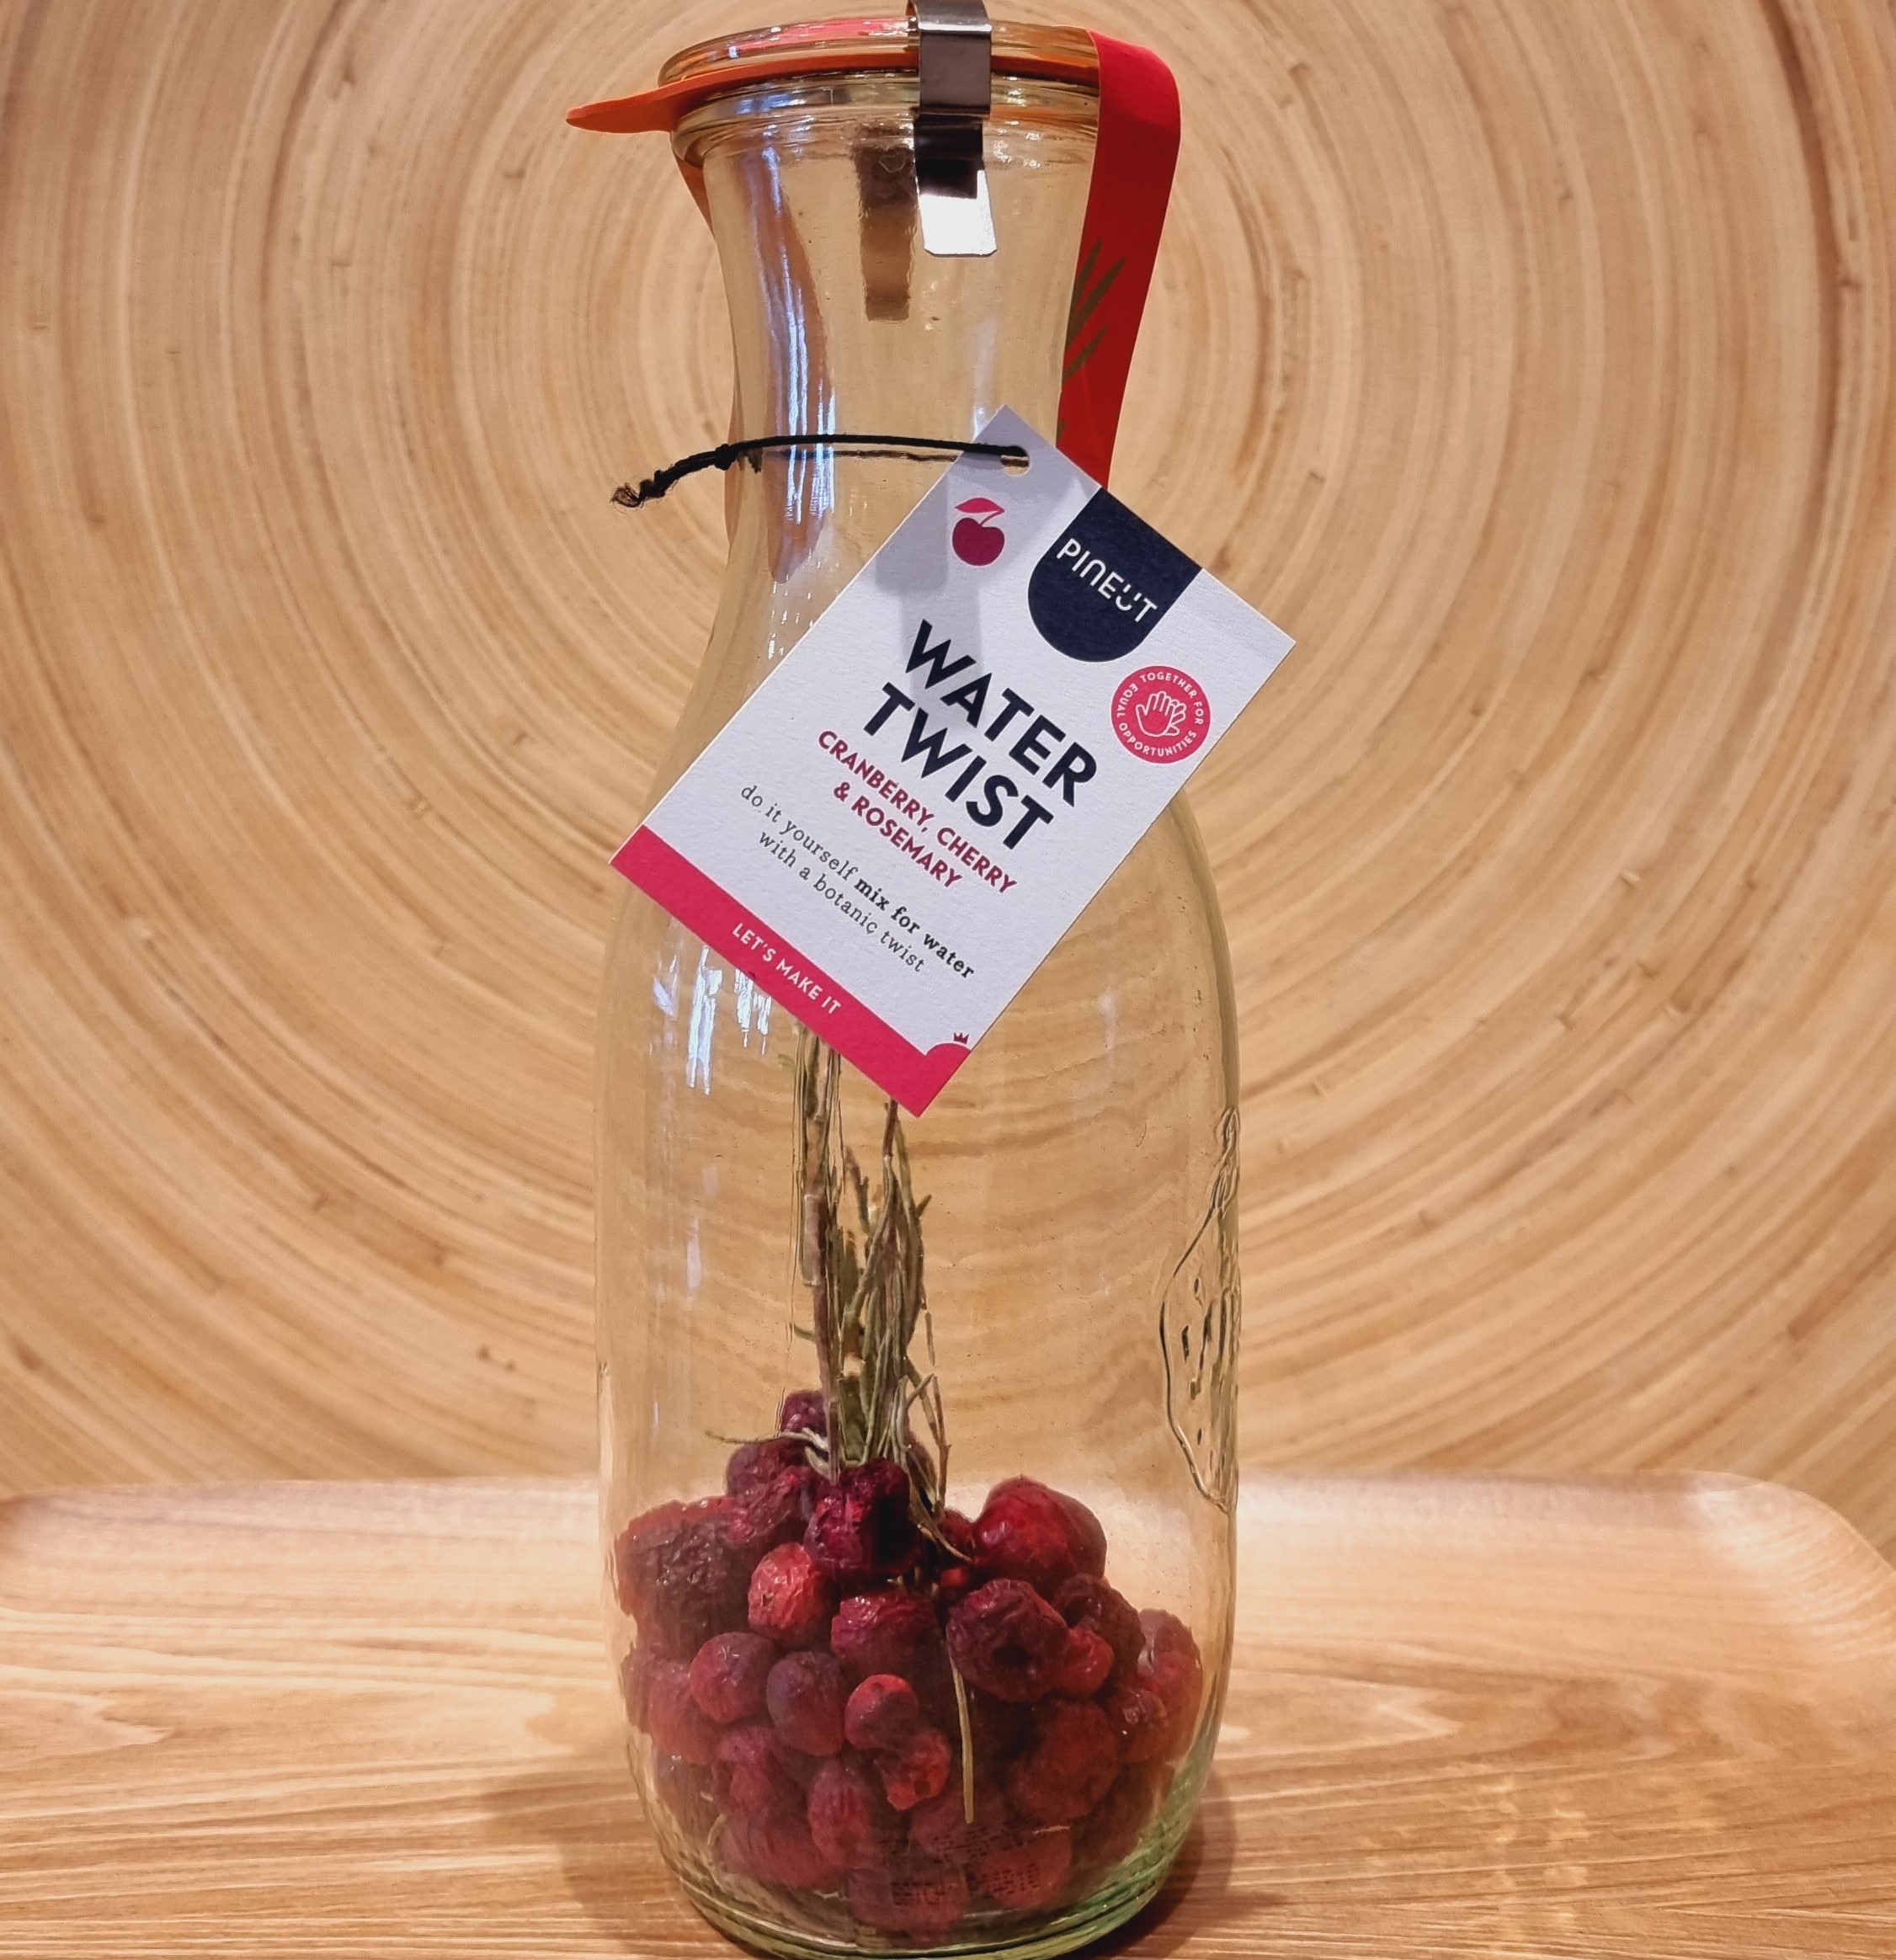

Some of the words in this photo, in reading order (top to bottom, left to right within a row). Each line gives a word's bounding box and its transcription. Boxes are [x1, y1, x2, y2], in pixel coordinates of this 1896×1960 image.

[905, 619, 1097, 808] WATER
[1116, 683, 1138, 718] EQUAL
[1119, 722, 1197, 757] OPPORTUNITIES
[1139, 672, 1197, 699] TOGETHER
[1194, 701, 1204, 725] FOR
[818, 731, 935, 833] CRANBERRY,
[936, 827, 1017, 893] CHERRY
[863, 681, 1054, 850] TWIST
[741, 785, 763, 807] do
[765, 803, 782, 823] it
[780, 820, 859, 881] yourself
[854, 878, 890, 911] mix
[890, 906, 920, 935] for
[923, 934, 975, 978] water
[833, 781, 850, 802] &
[850, 795, 963, 887] ROSEMARY
[759, 832, 796, 868] with
[799, 866, 812, 880] a
[813, 873, 877, 935] botanic
[881, 930, 927, 972] twist
[732, 923, 776, 961] LET'S
[775, 958, 823, 1000] MAKE
[821, 996, 841, 1014] IT
